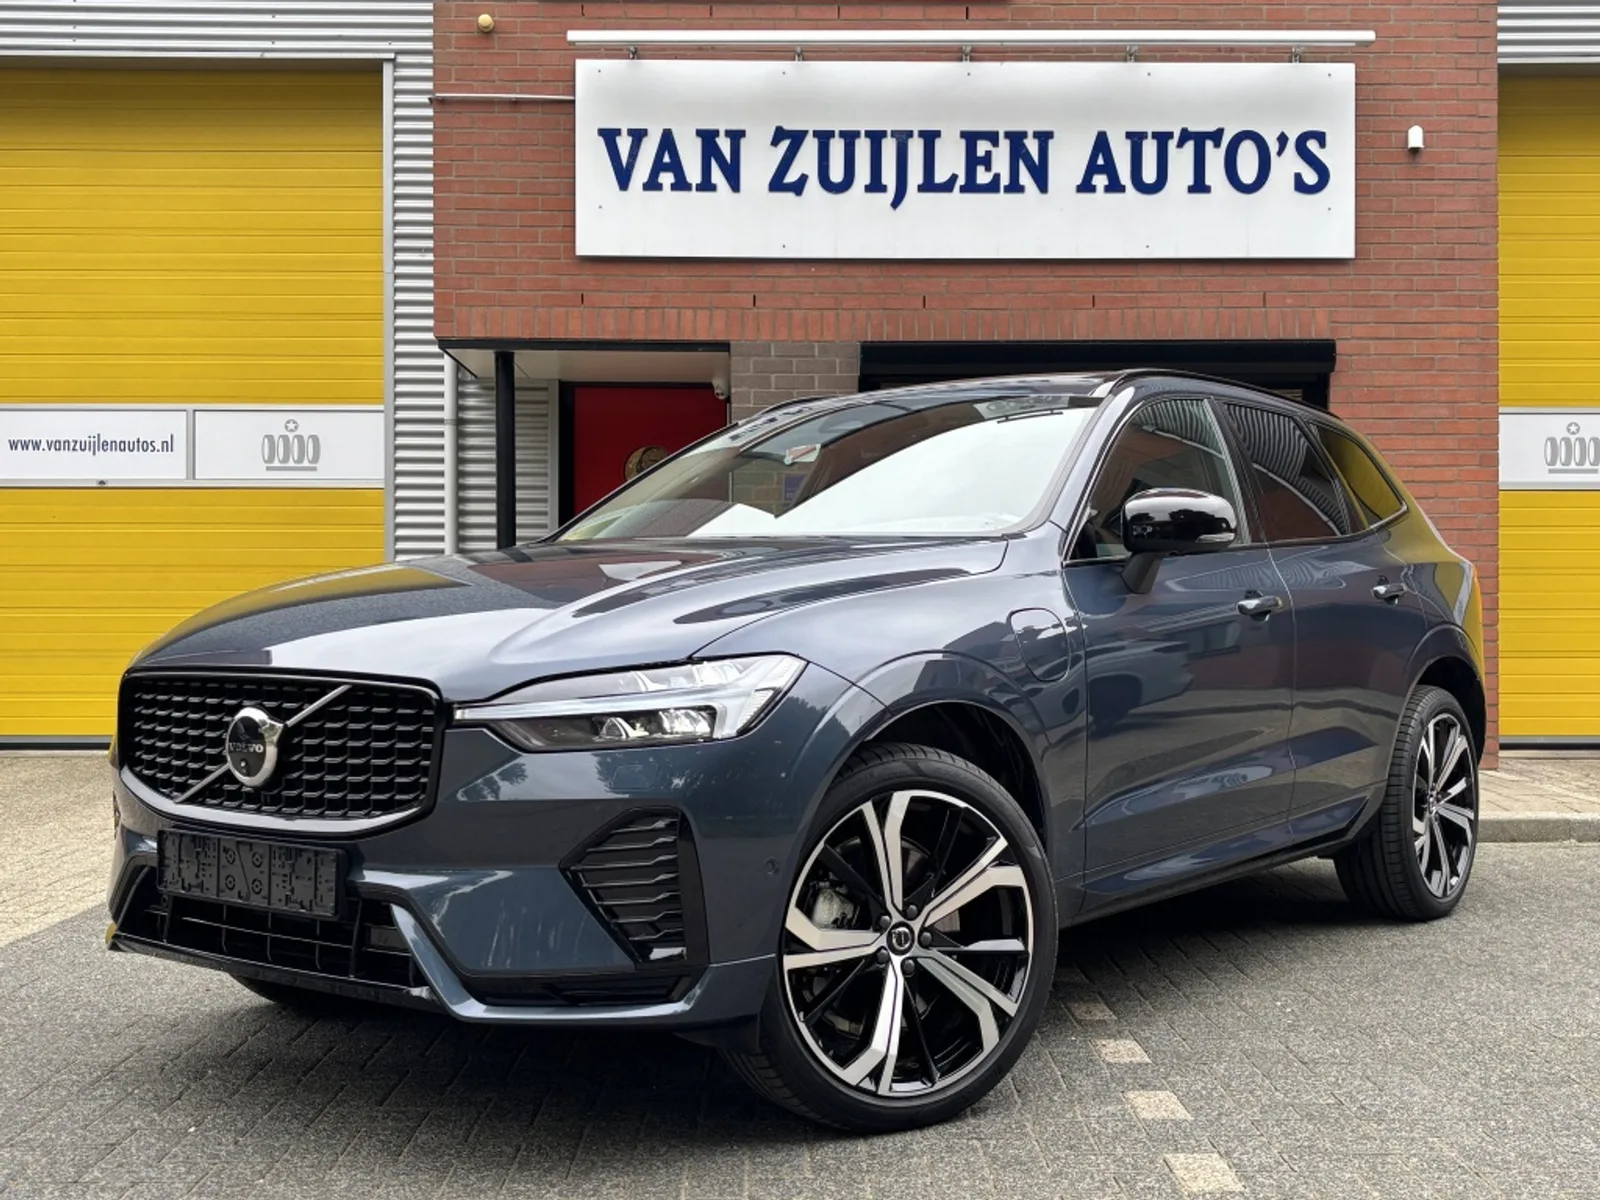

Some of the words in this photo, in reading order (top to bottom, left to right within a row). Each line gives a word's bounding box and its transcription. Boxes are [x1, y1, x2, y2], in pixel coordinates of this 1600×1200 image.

[597, 127, 747, 194] VAN
[768, 125, 1055, 211] ZUIJLEN
[1075, 126, 1331, 196] AUTO'S
[8, 433, 174, 456] www.vanzuijlenautos.nl
